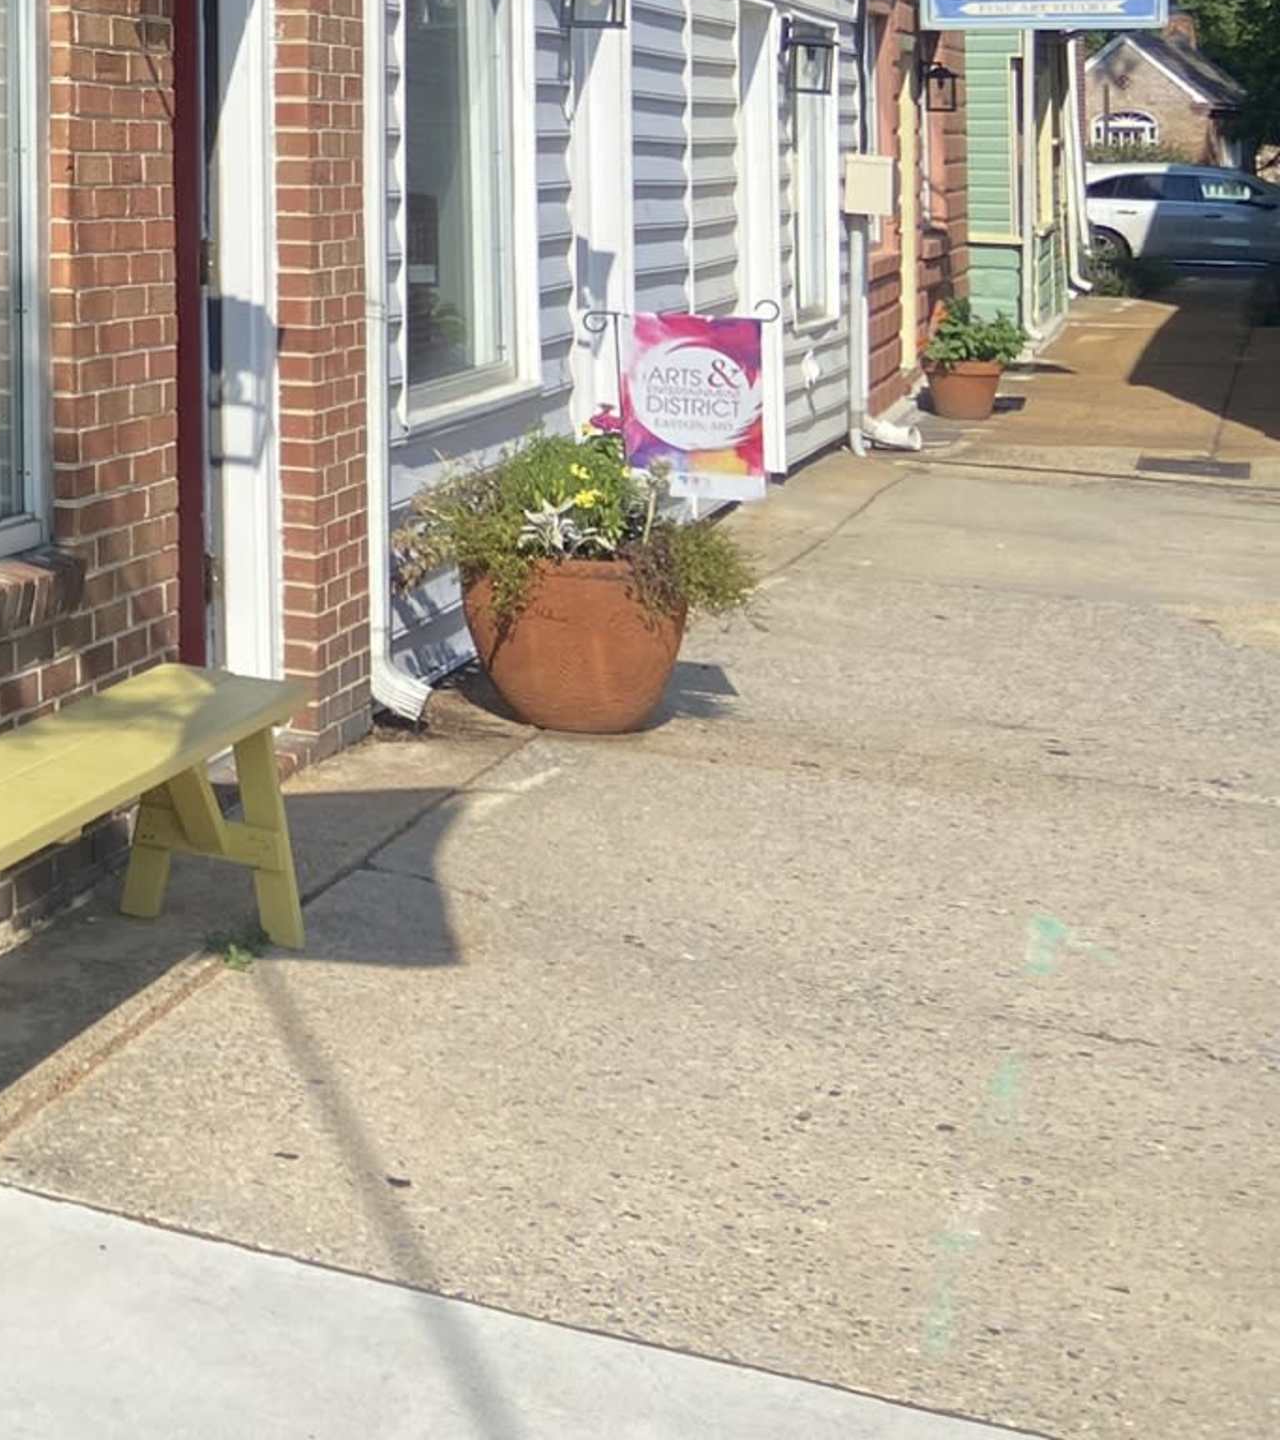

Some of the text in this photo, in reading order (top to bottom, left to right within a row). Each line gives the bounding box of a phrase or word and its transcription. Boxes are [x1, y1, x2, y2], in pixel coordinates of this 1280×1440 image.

[647, 359, 741, 389] ARTS &
[646, 395, 740, 418] DISTRICT
